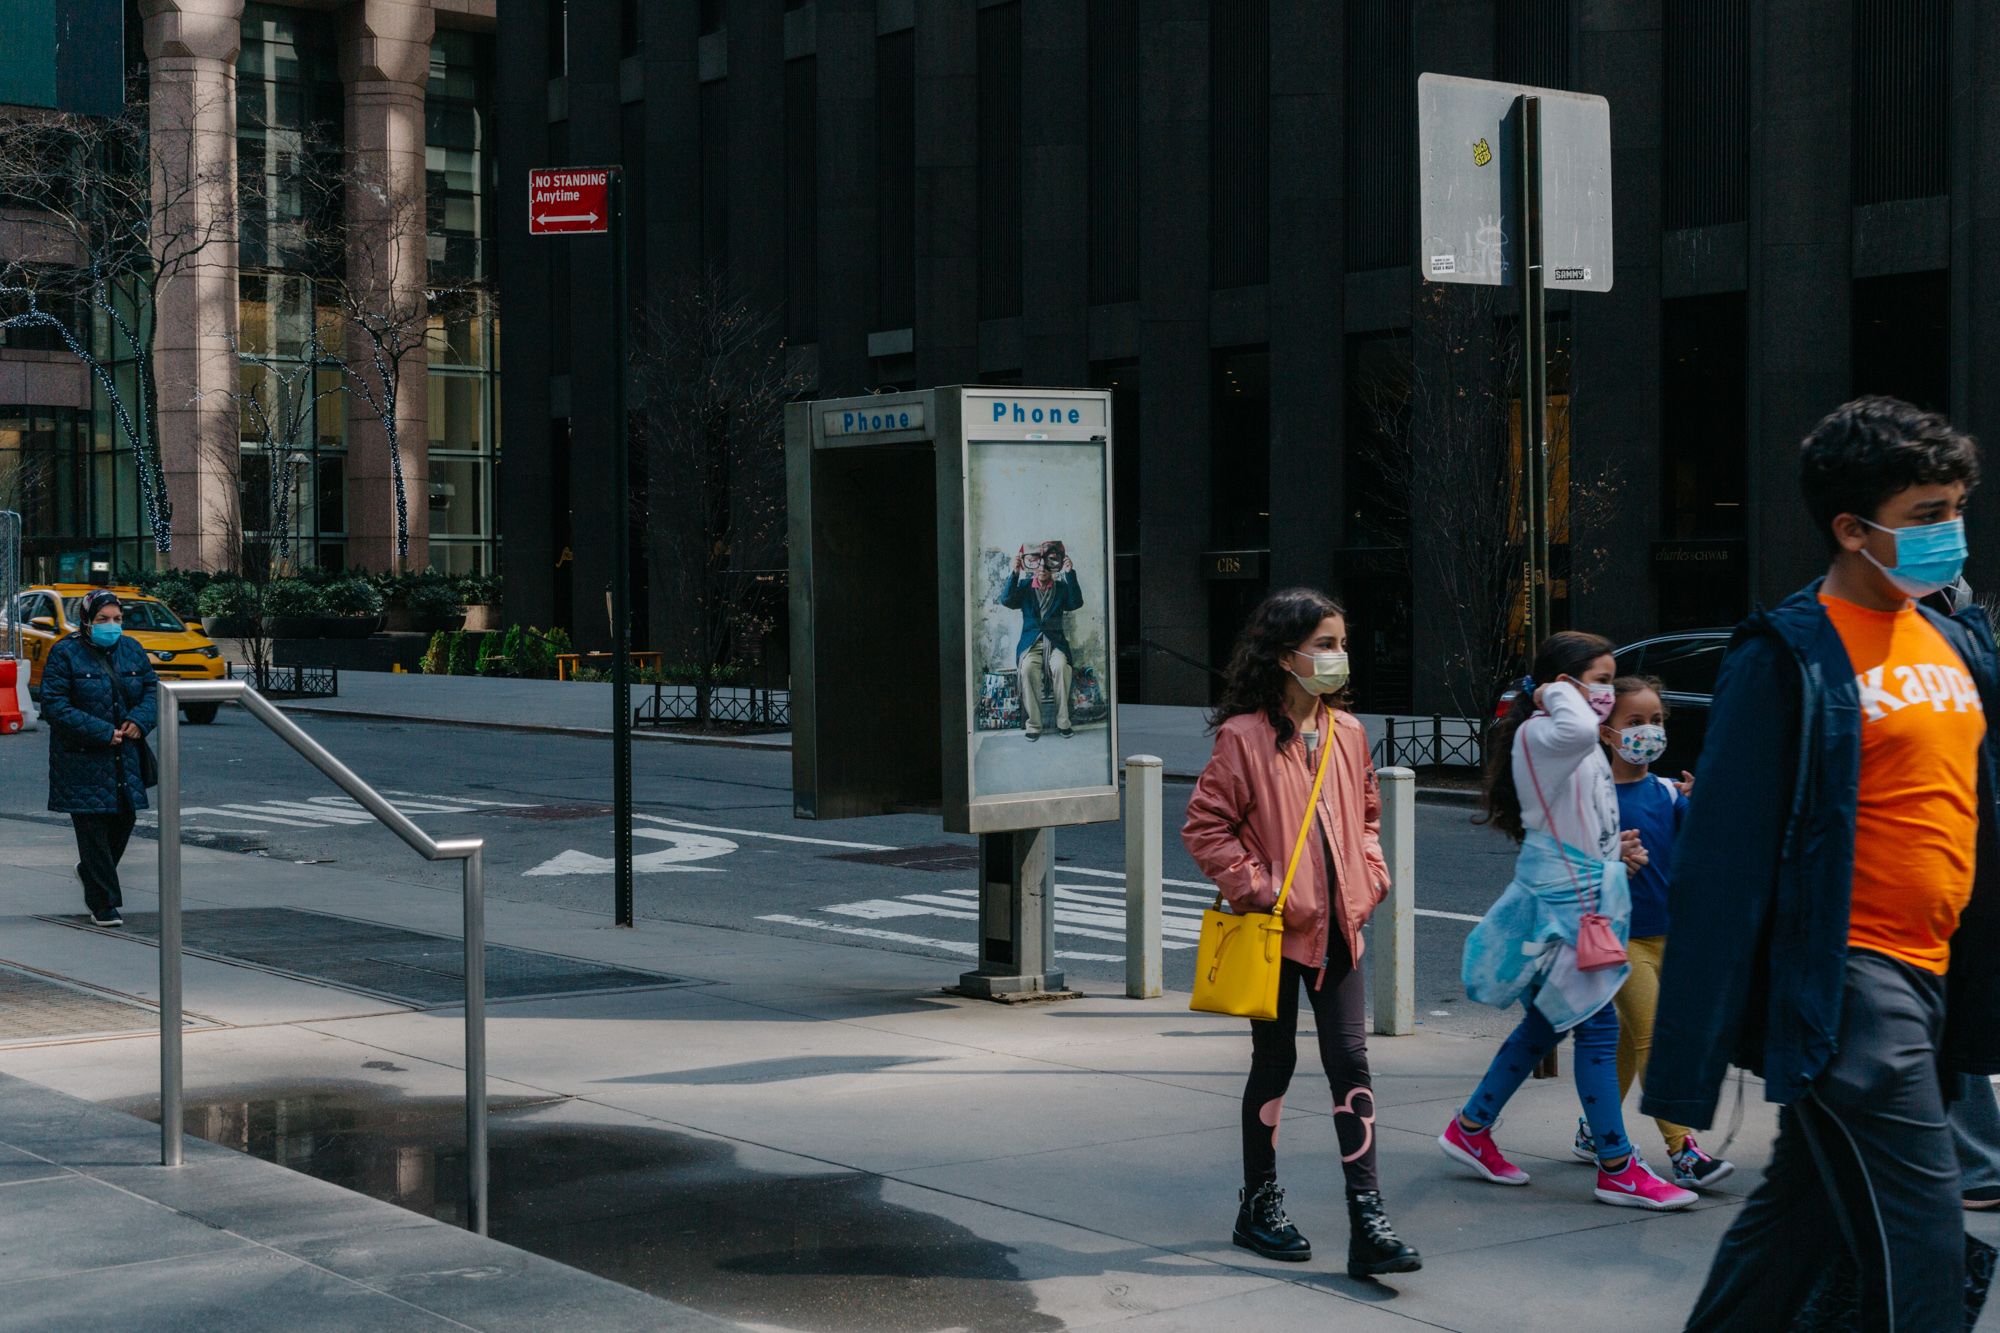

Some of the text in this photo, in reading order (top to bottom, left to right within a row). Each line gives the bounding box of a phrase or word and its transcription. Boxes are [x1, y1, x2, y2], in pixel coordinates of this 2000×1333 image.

[535, 173, 606, 188] NO STANDING
[536, 189, 580, 204] Anytime
[1555, 270, 1583, 280] SAMMY
[992, 402, 1080, 424] Phone
[844, 411, 910, 433] Phone
[1217, 557, 1240, 572] CBS
